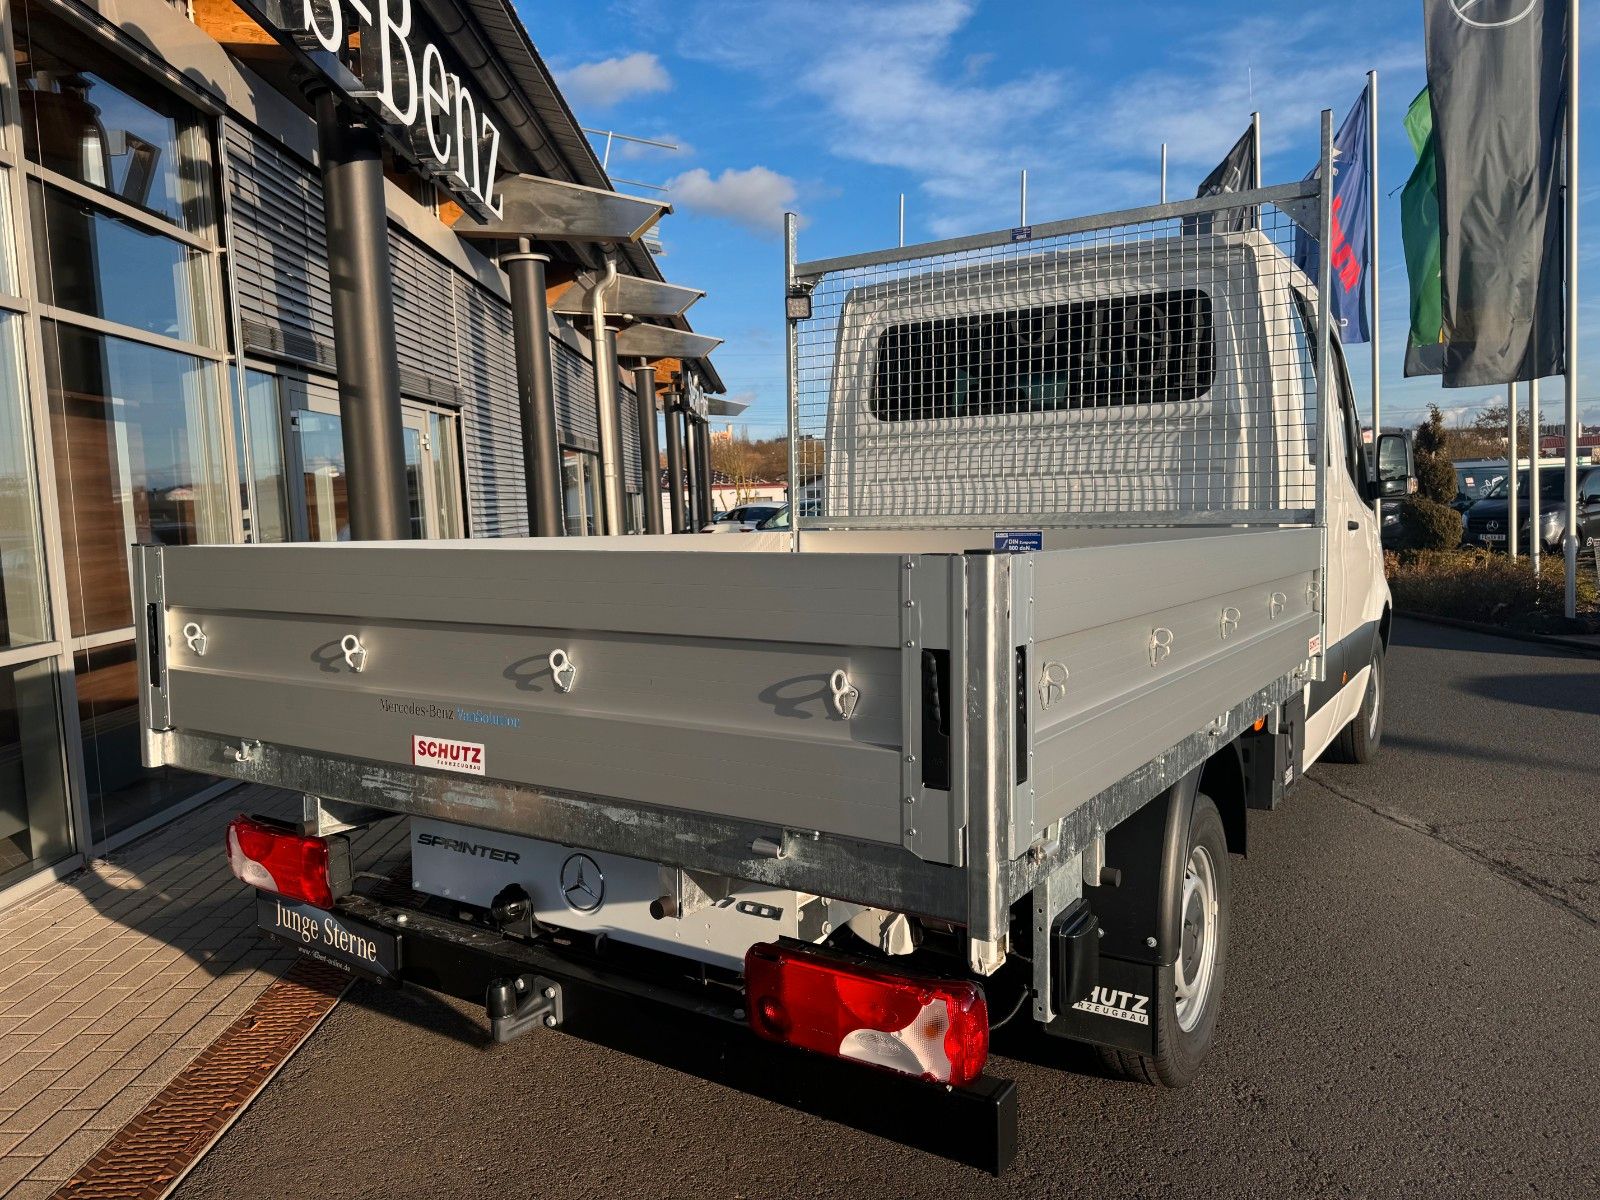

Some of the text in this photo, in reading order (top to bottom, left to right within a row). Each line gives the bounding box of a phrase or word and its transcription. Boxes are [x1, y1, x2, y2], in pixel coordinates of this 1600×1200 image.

[378, 698, 454, 720] Mercedes-Benz
[417, 740, 482, 764] SCHUTZ
[417, 832, 521, 866] SPRINTER
[275, 900, 377, 963] Junge Sterne
